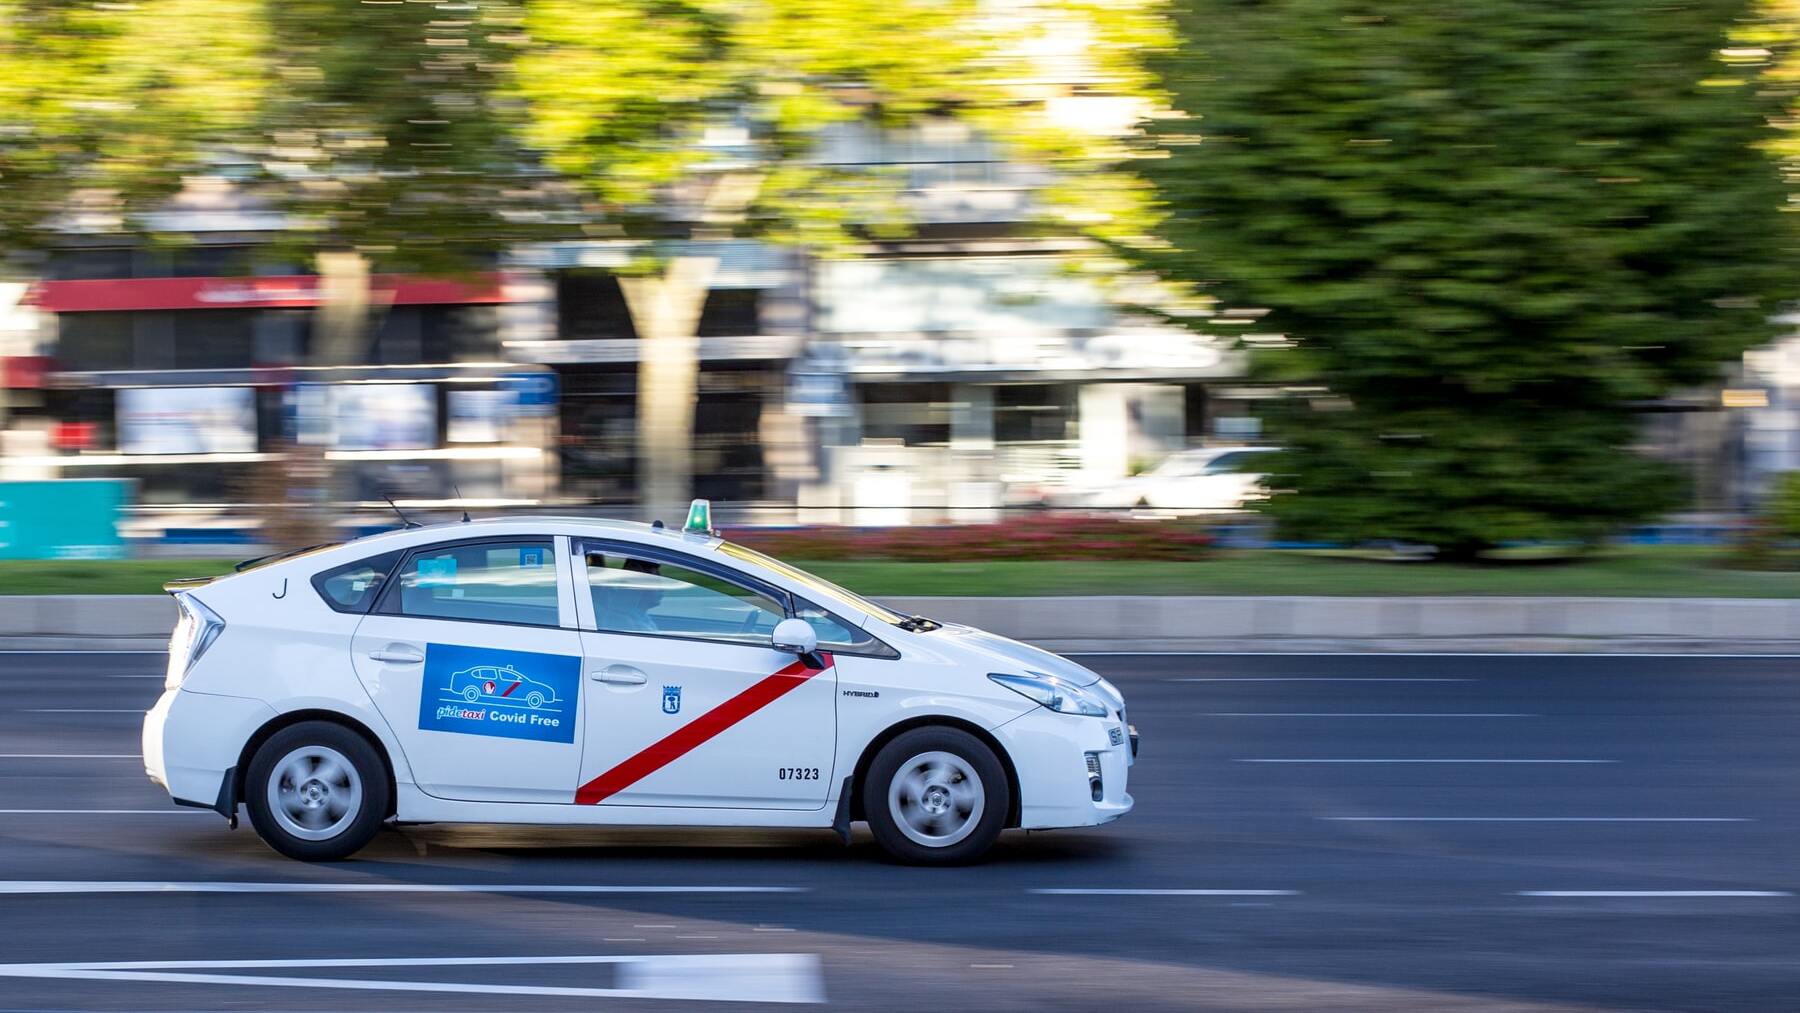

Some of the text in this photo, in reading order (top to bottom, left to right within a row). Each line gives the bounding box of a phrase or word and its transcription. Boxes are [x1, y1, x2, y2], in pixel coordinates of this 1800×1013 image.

[272, 578, 288, 599] J
[437, 705, 560, 727] pidetaxi Covid Free
[779, 768, 819, 780] 07323
